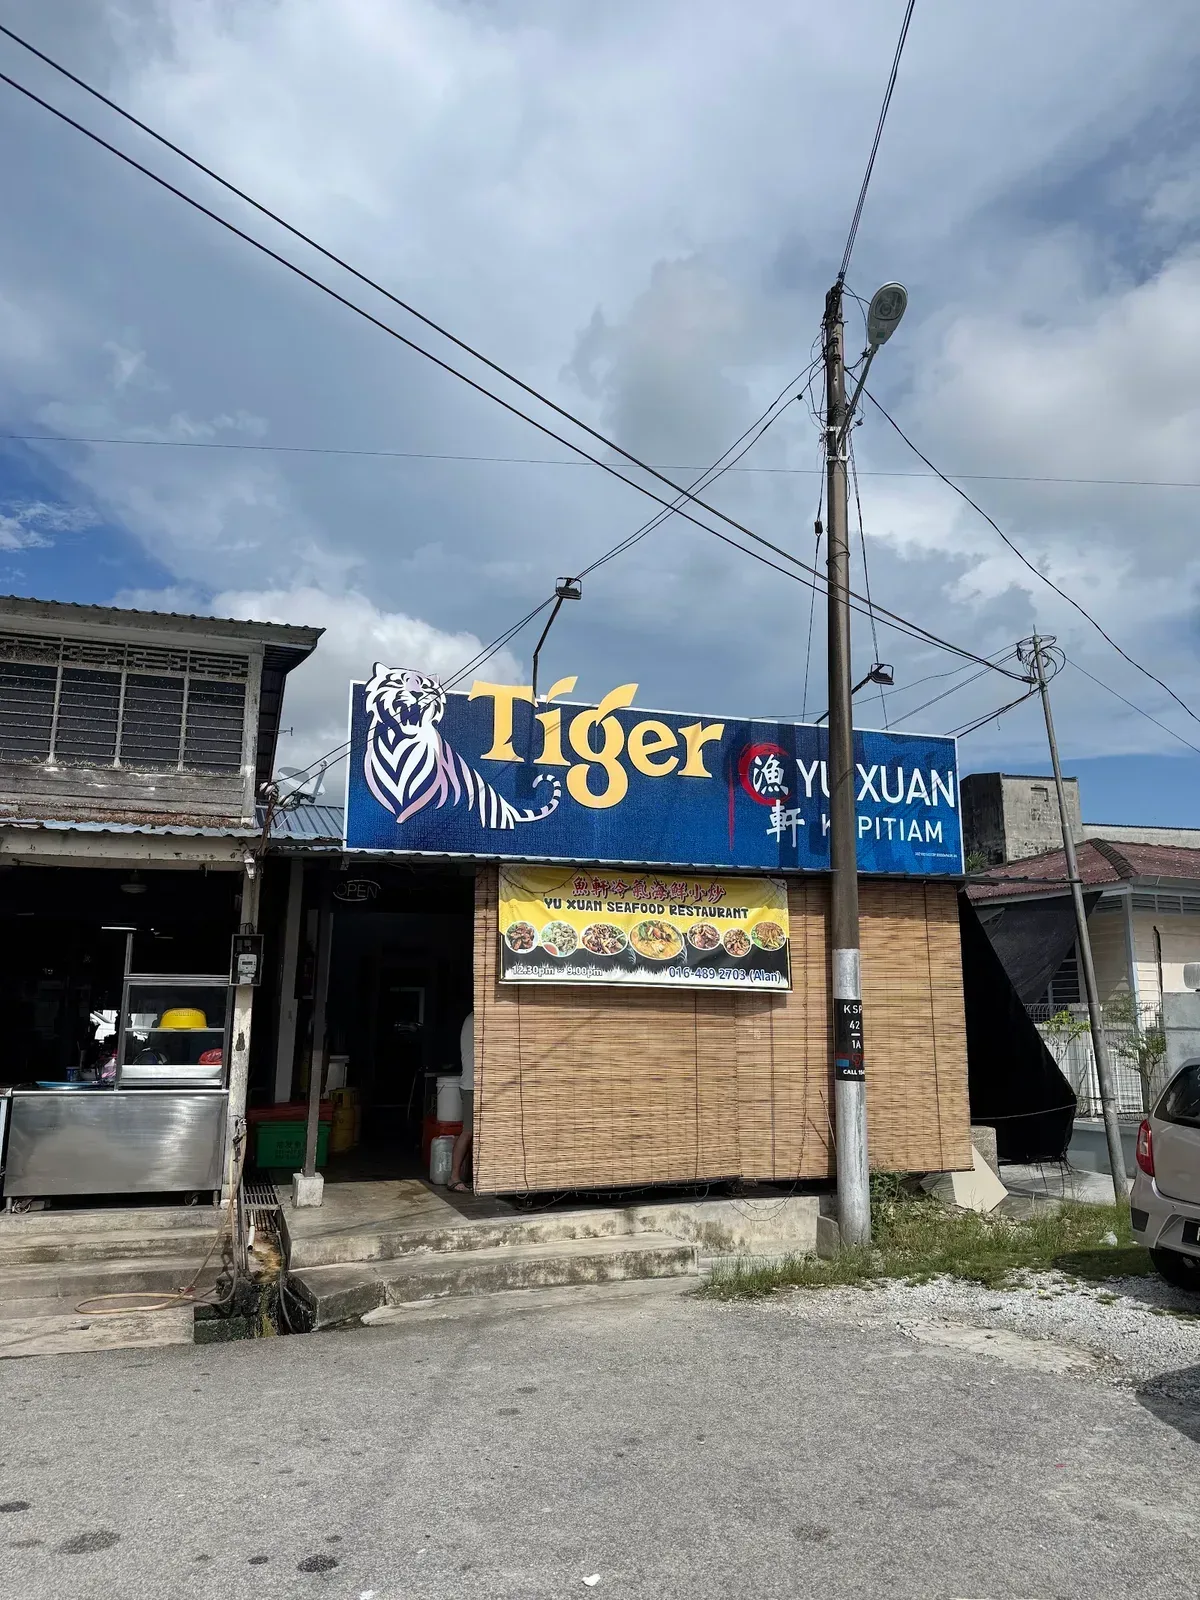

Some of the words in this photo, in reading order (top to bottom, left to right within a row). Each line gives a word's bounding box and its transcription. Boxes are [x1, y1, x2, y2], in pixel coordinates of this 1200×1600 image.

[468, 676, 725, 809] Tiger
[856, 763, 955, 808] XUAN
[822, 813, 943, 844] KPITIAM
[336, 883, 378, 899] OPEN
[544, 897, 562, 910] YU
[566, 899, 602, 912] XUAN
[607, 902, 665, 915] SEAFOOD
[669, 904, 749, 919] RESTAURANT
[512, 965, 555, 977] 12.30pm
[566, 966, 602, 978] 9.00pm
[669, 966, 715, 979] 016-489
[719, 969, 746, 980] 2703
[749, 969, 781, 984] (Alan)
[849, 1020, 860, 1030] 42
[852, 1039, 861, 1049] 1A
